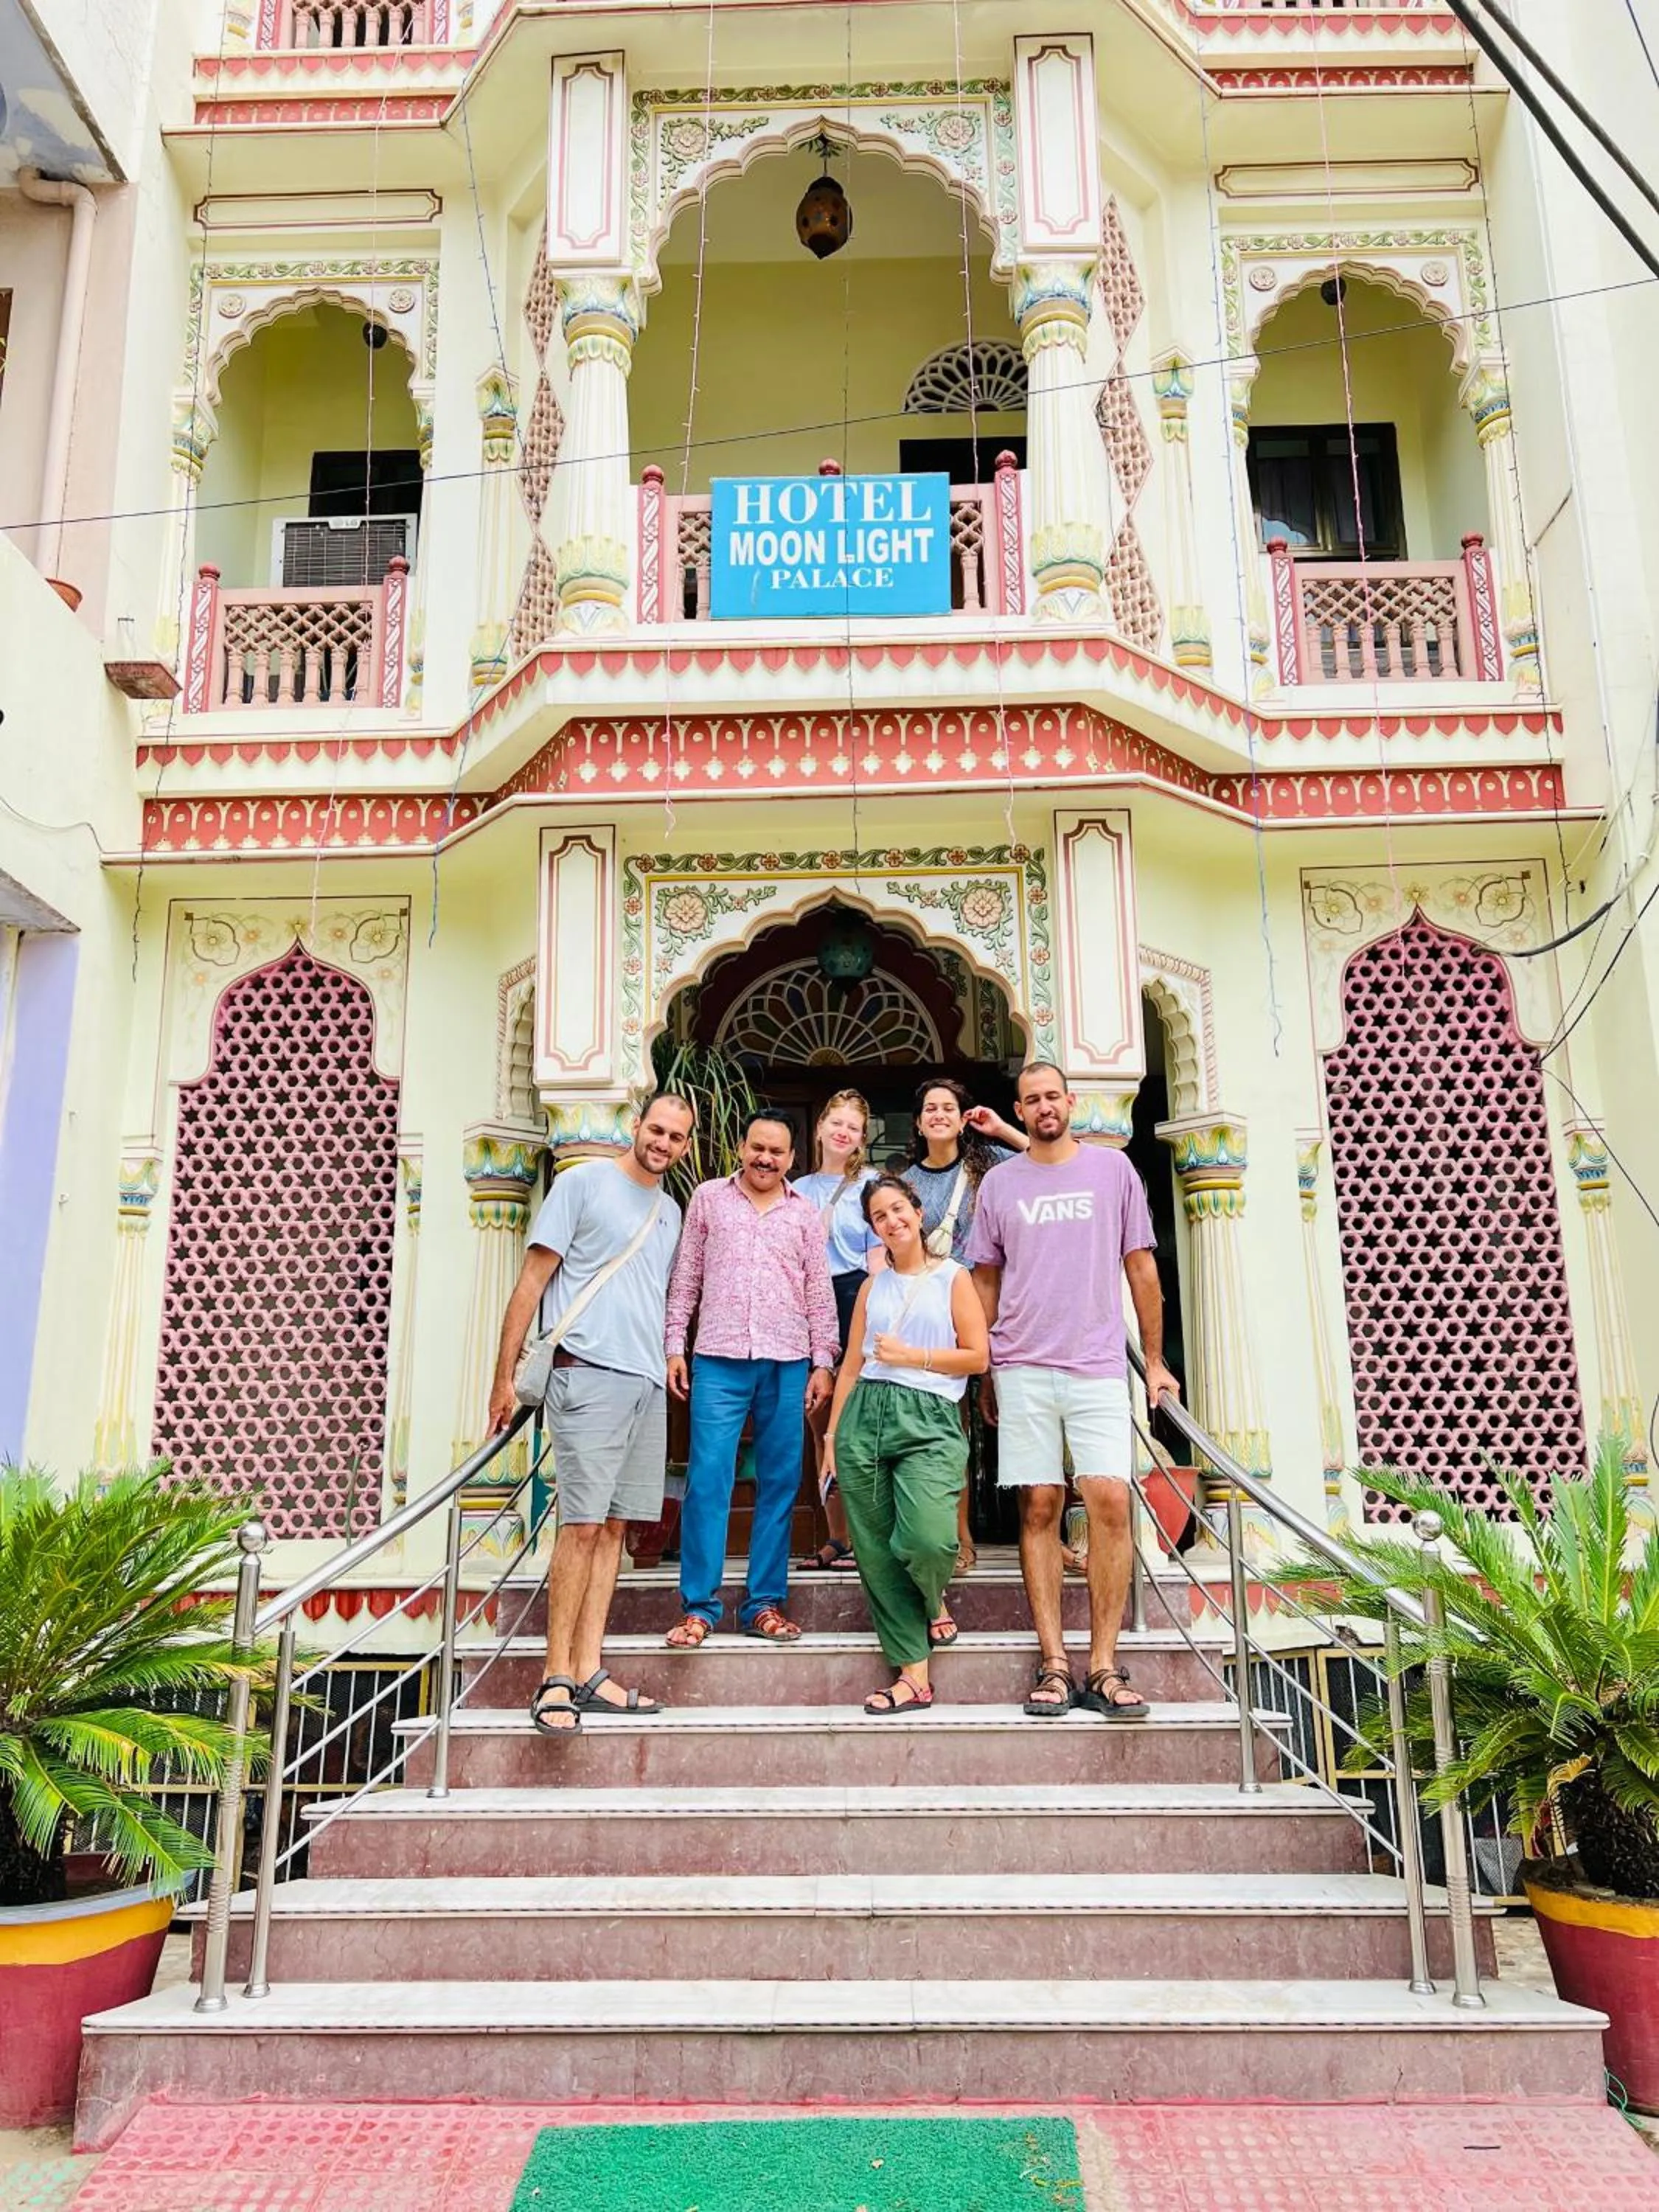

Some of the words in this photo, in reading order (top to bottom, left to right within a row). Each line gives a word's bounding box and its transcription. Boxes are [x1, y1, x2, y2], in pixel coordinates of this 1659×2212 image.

[732, 481, 931, 524] HOTEL
[729, 530, 826, 566] MOON
[837, 528, 934, 564] LIGHT
[771, 567, 894, 589] PALACE
[1018, 1192, 1094, 1225] VANS
